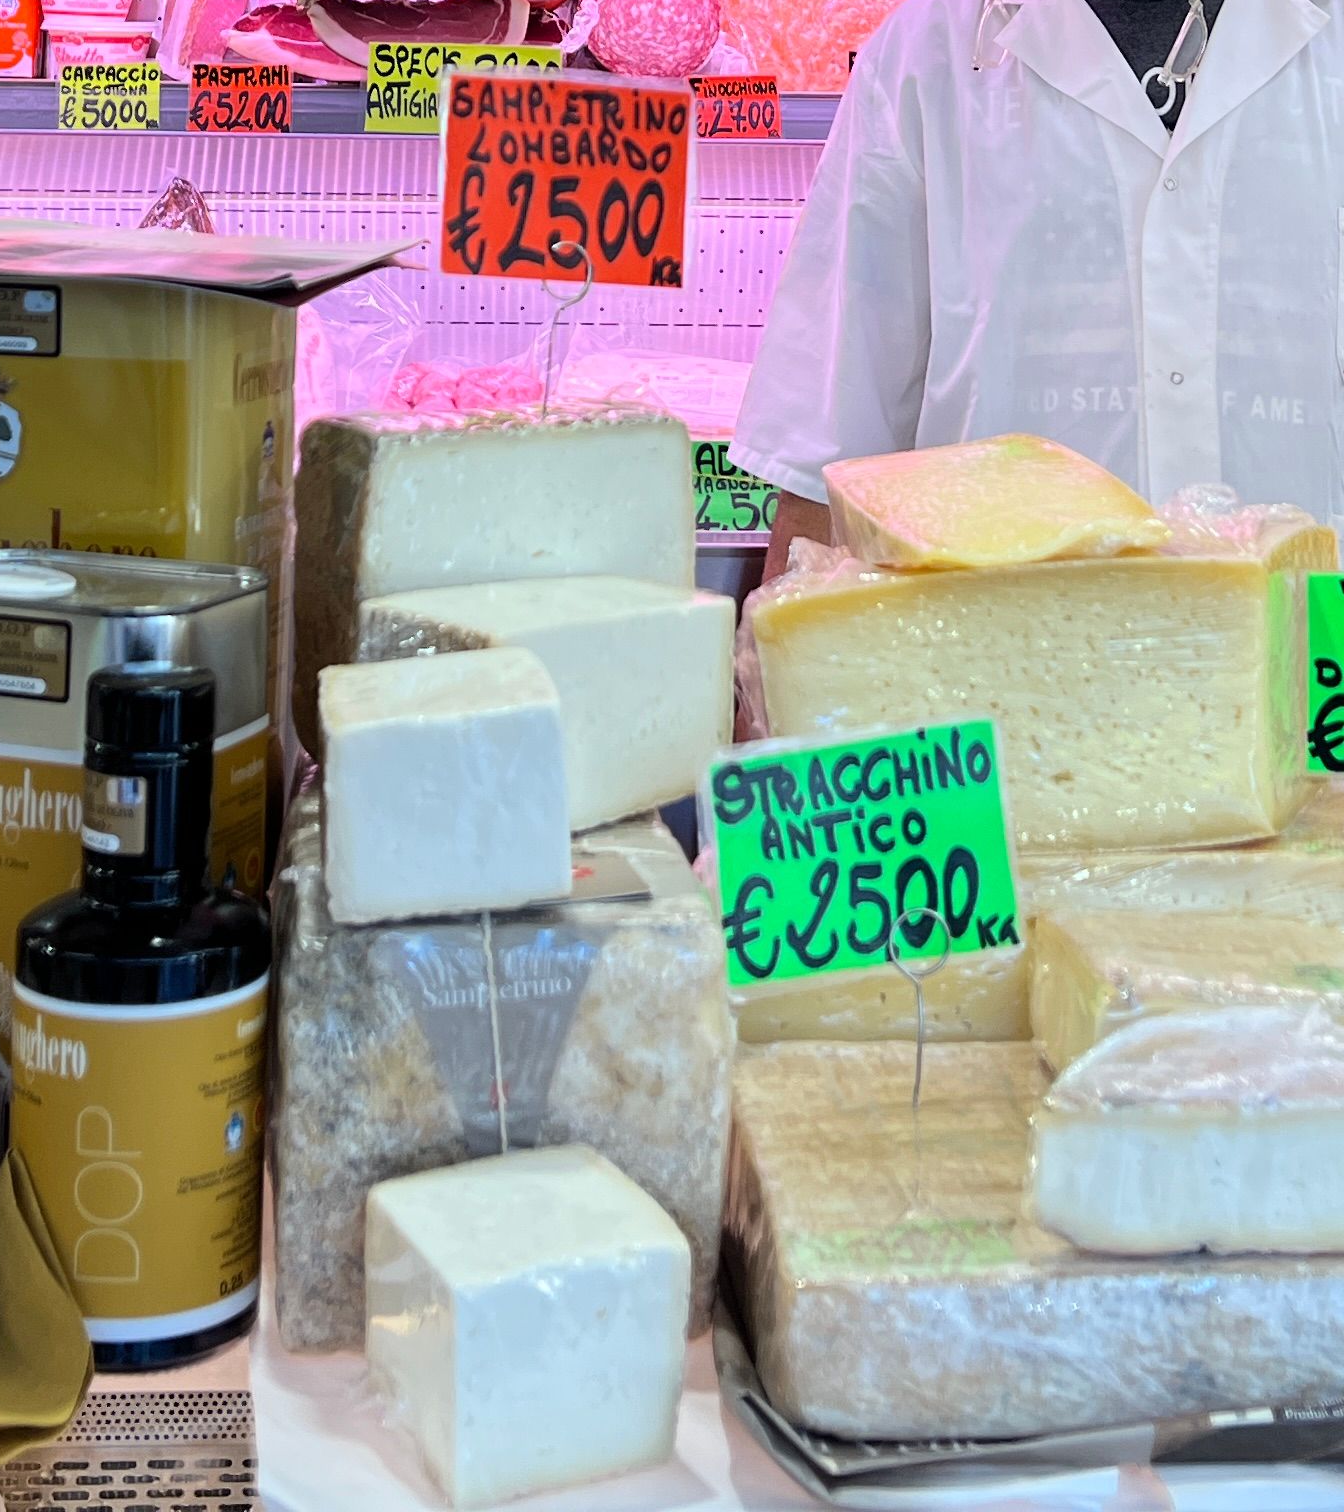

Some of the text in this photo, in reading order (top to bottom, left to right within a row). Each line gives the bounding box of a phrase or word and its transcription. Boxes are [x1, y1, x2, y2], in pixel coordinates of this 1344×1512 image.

[374, 44, 463, 75] SPECK
[421, 971, 572, 1009] Sampetrino
[74, 1105, 144, 1284] DOP
